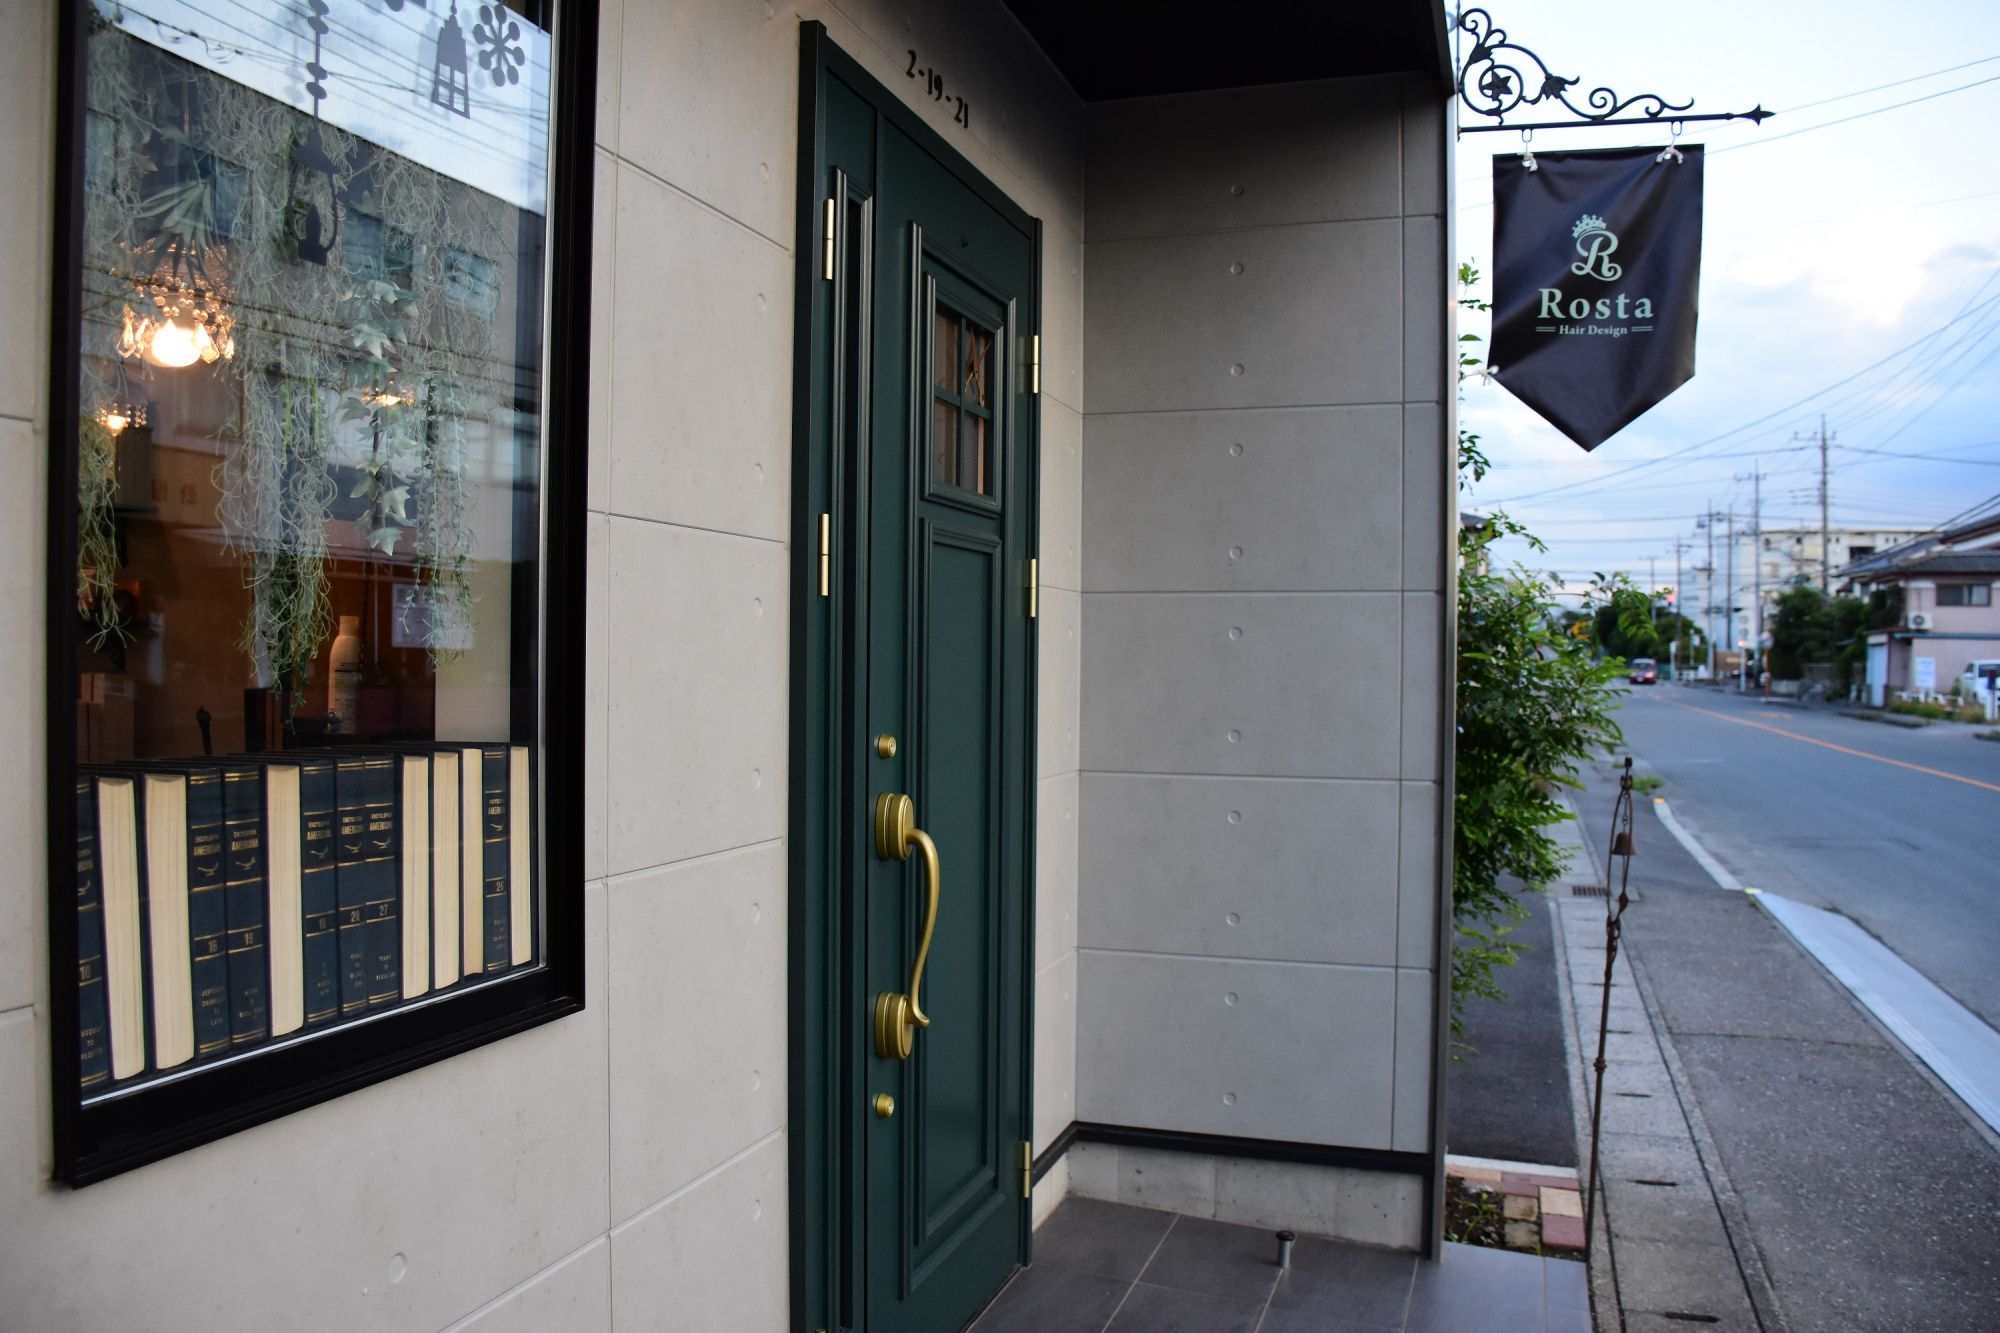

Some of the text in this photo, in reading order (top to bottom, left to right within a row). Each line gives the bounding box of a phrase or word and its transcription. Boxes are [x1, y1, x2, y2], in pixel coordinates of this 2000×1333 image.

[1537, 288, 1654, 319] Rosta
[1560, 325, 1628, 338] Hair Design
[379, 904, 389, 916] 27
